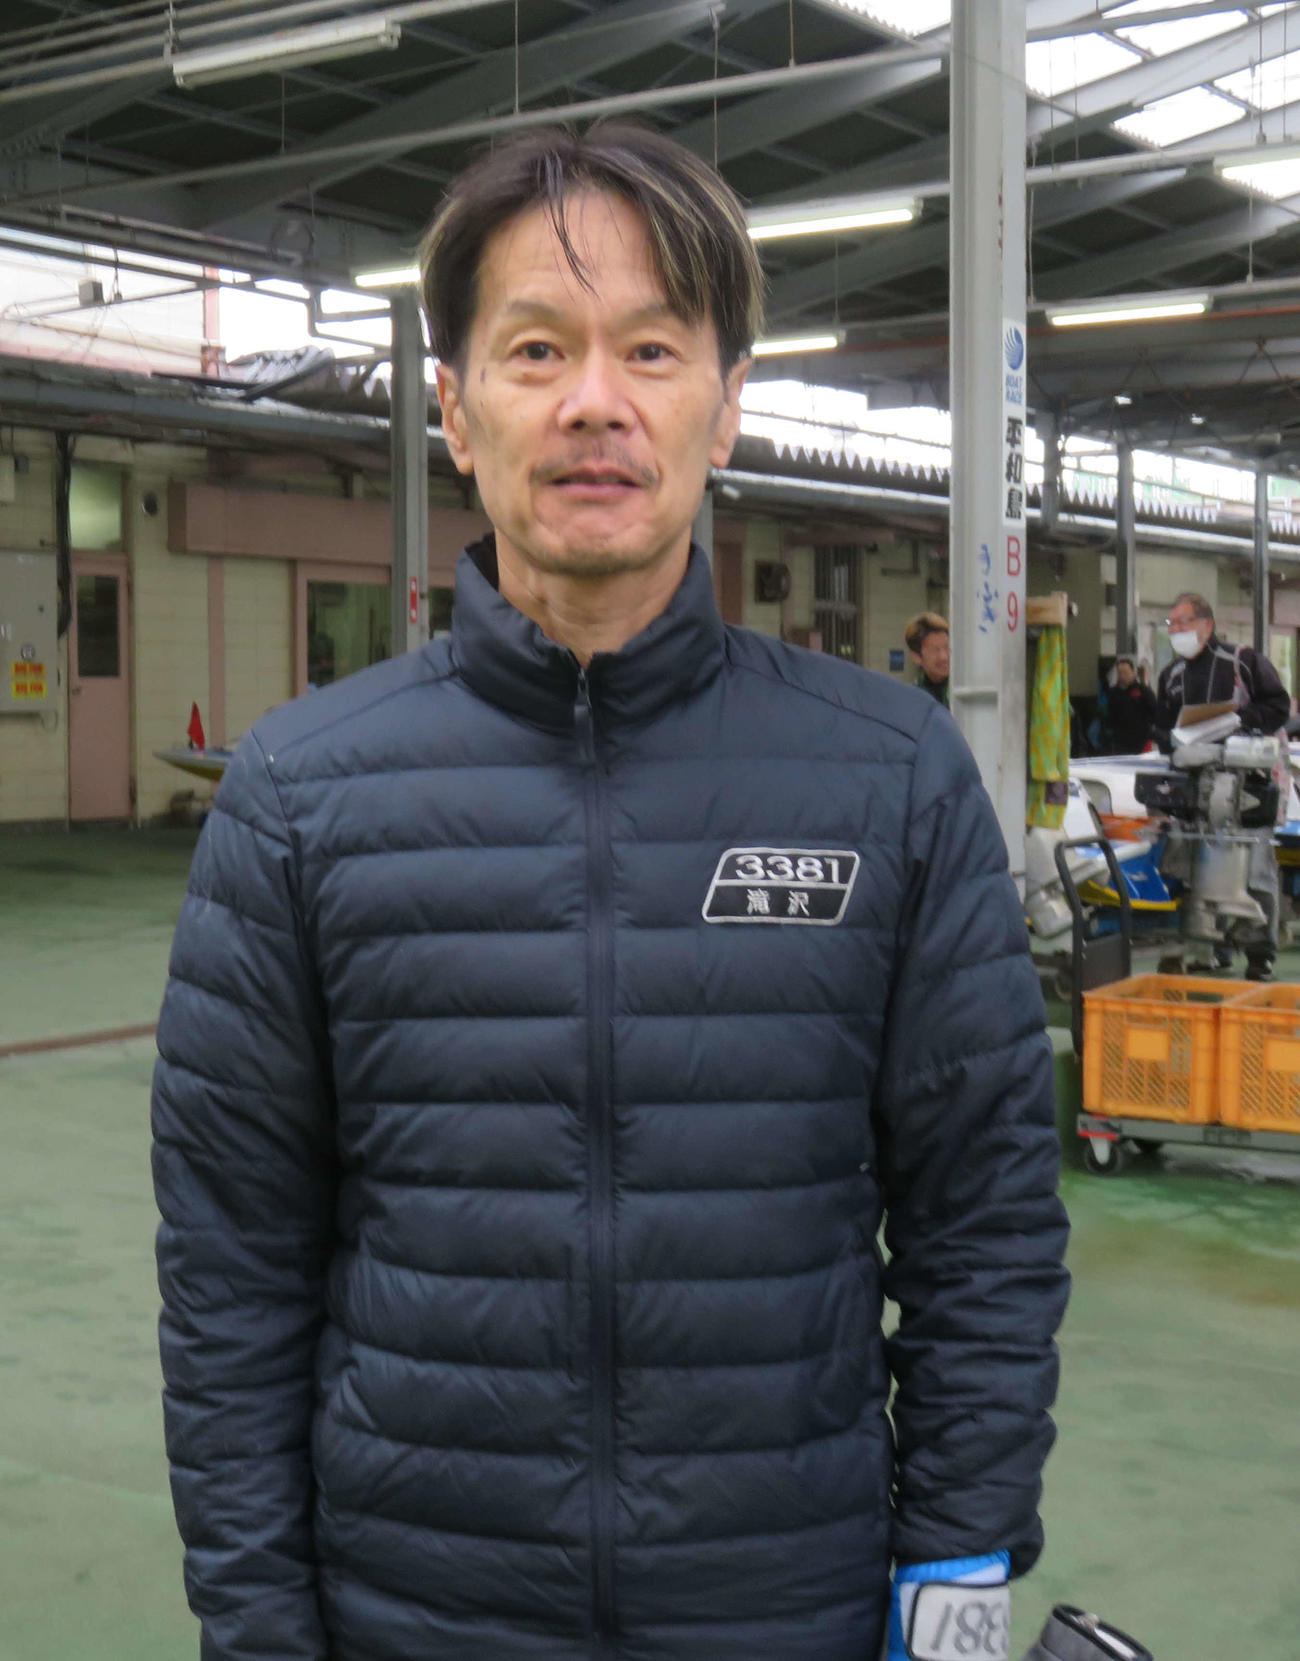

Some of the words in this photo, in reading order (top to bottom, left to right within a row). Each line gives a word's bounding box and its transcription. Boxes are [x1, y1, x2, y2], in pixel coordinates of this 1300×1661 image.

[1005, 375, 1022, 388] BOAT
[1005, 389, 1022, 404] RACE
[1005, 416, 1023, 519] 平和島
[735, 855, 839, 883] 3381
